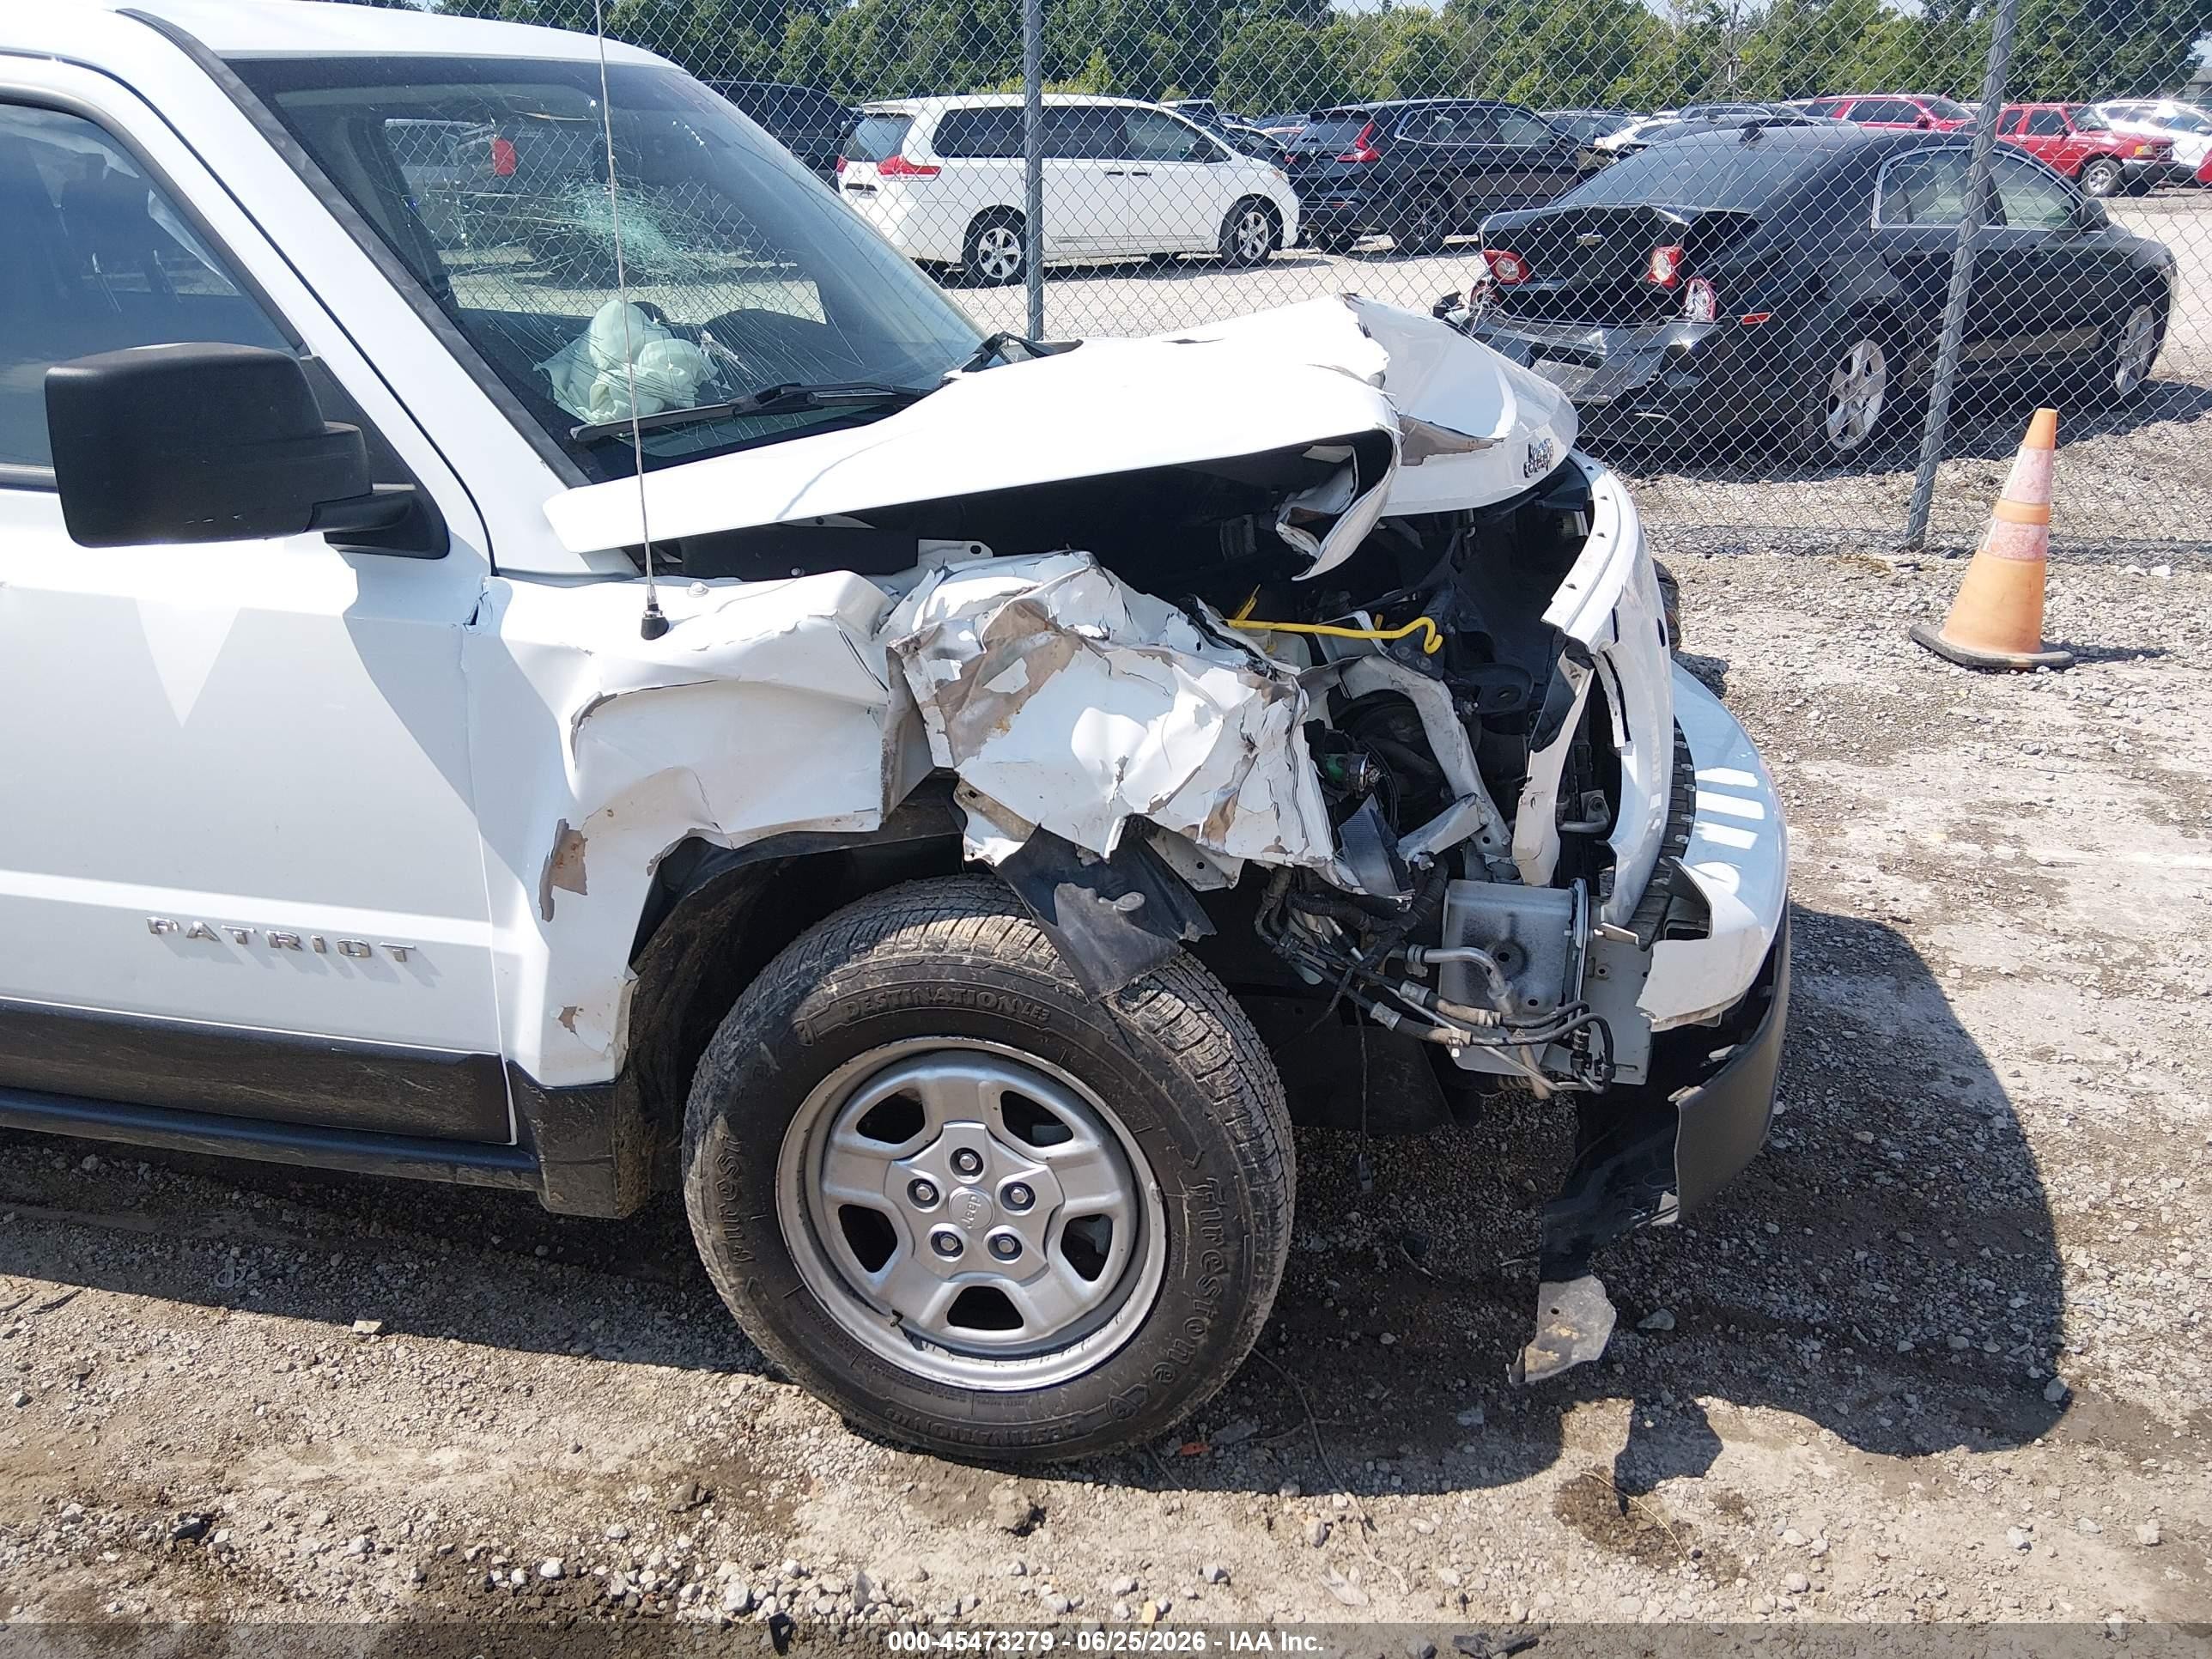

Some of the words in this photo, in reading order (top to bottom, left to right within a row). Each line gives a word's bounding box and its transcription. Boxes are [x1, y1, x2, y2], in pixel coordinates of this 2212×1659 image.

[146, 916, 416, 963] PATRIOT
[845, 988, 1025, 1017] DESTINATION
[961, 1194, 981, 1229] Jeep
[1152, 1176, 1227, 1384] Firestone
